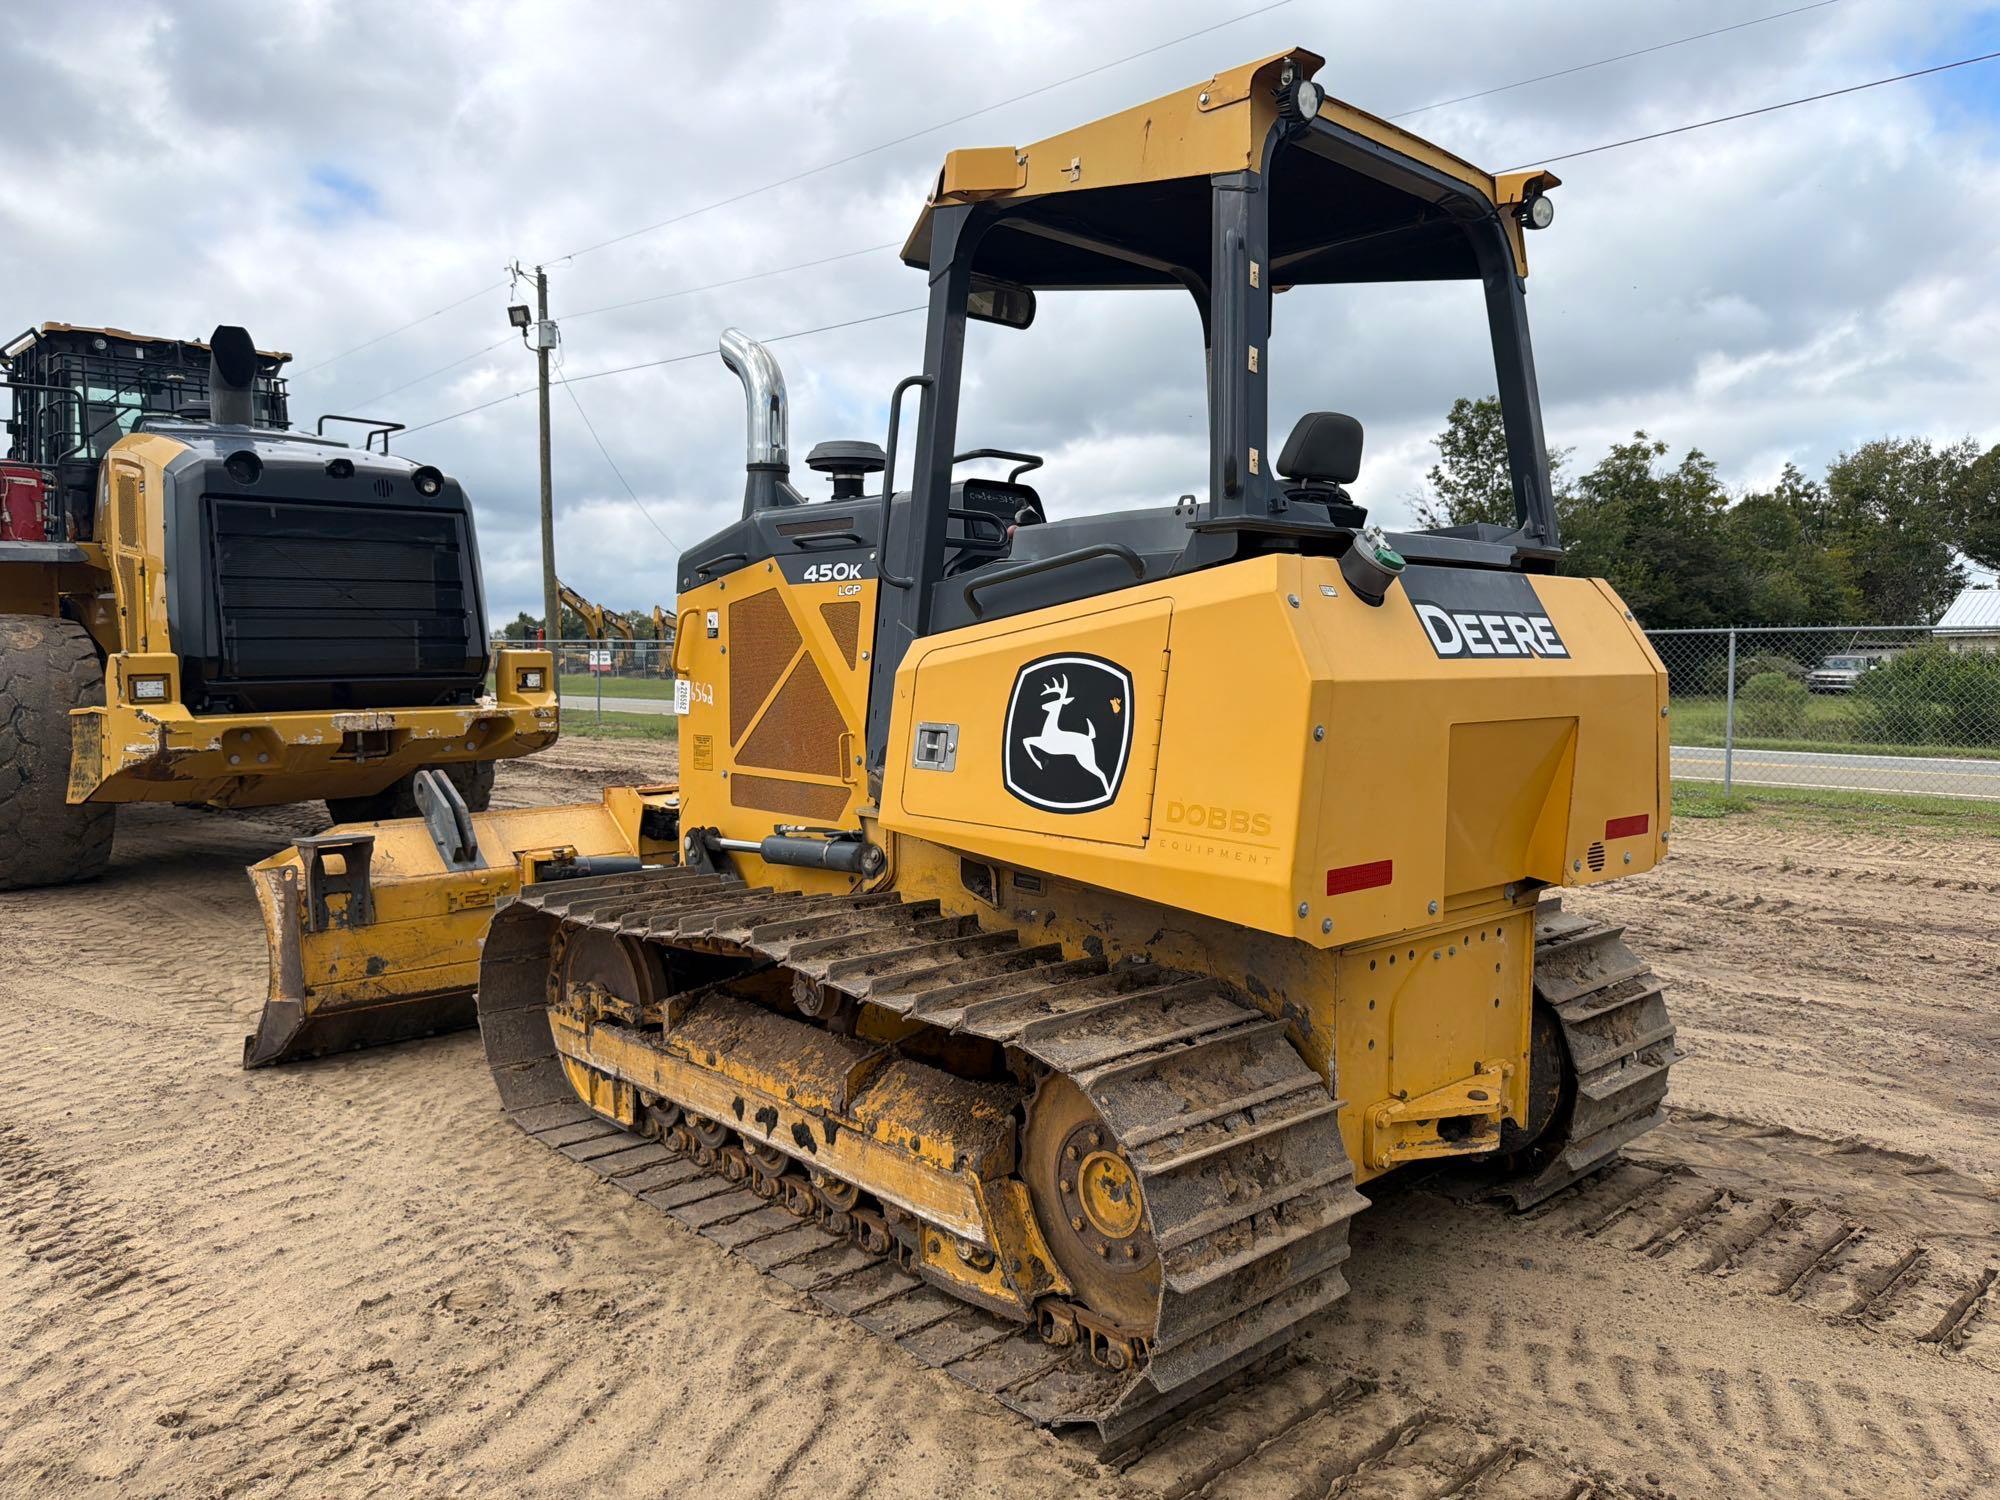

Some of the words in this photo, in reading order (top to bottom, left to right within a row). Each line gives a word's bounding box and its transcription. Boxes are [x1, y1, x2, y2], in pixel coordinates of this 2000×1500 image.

[803, 562, 863, 582] 450K
[838, 584, 862, 596] LGP
[1414, 604, 1567, 654] DEERE
[1166, 800, 1273, 837] DOBBS
[1159, 839, 1273, 865] EQUIPMENT
